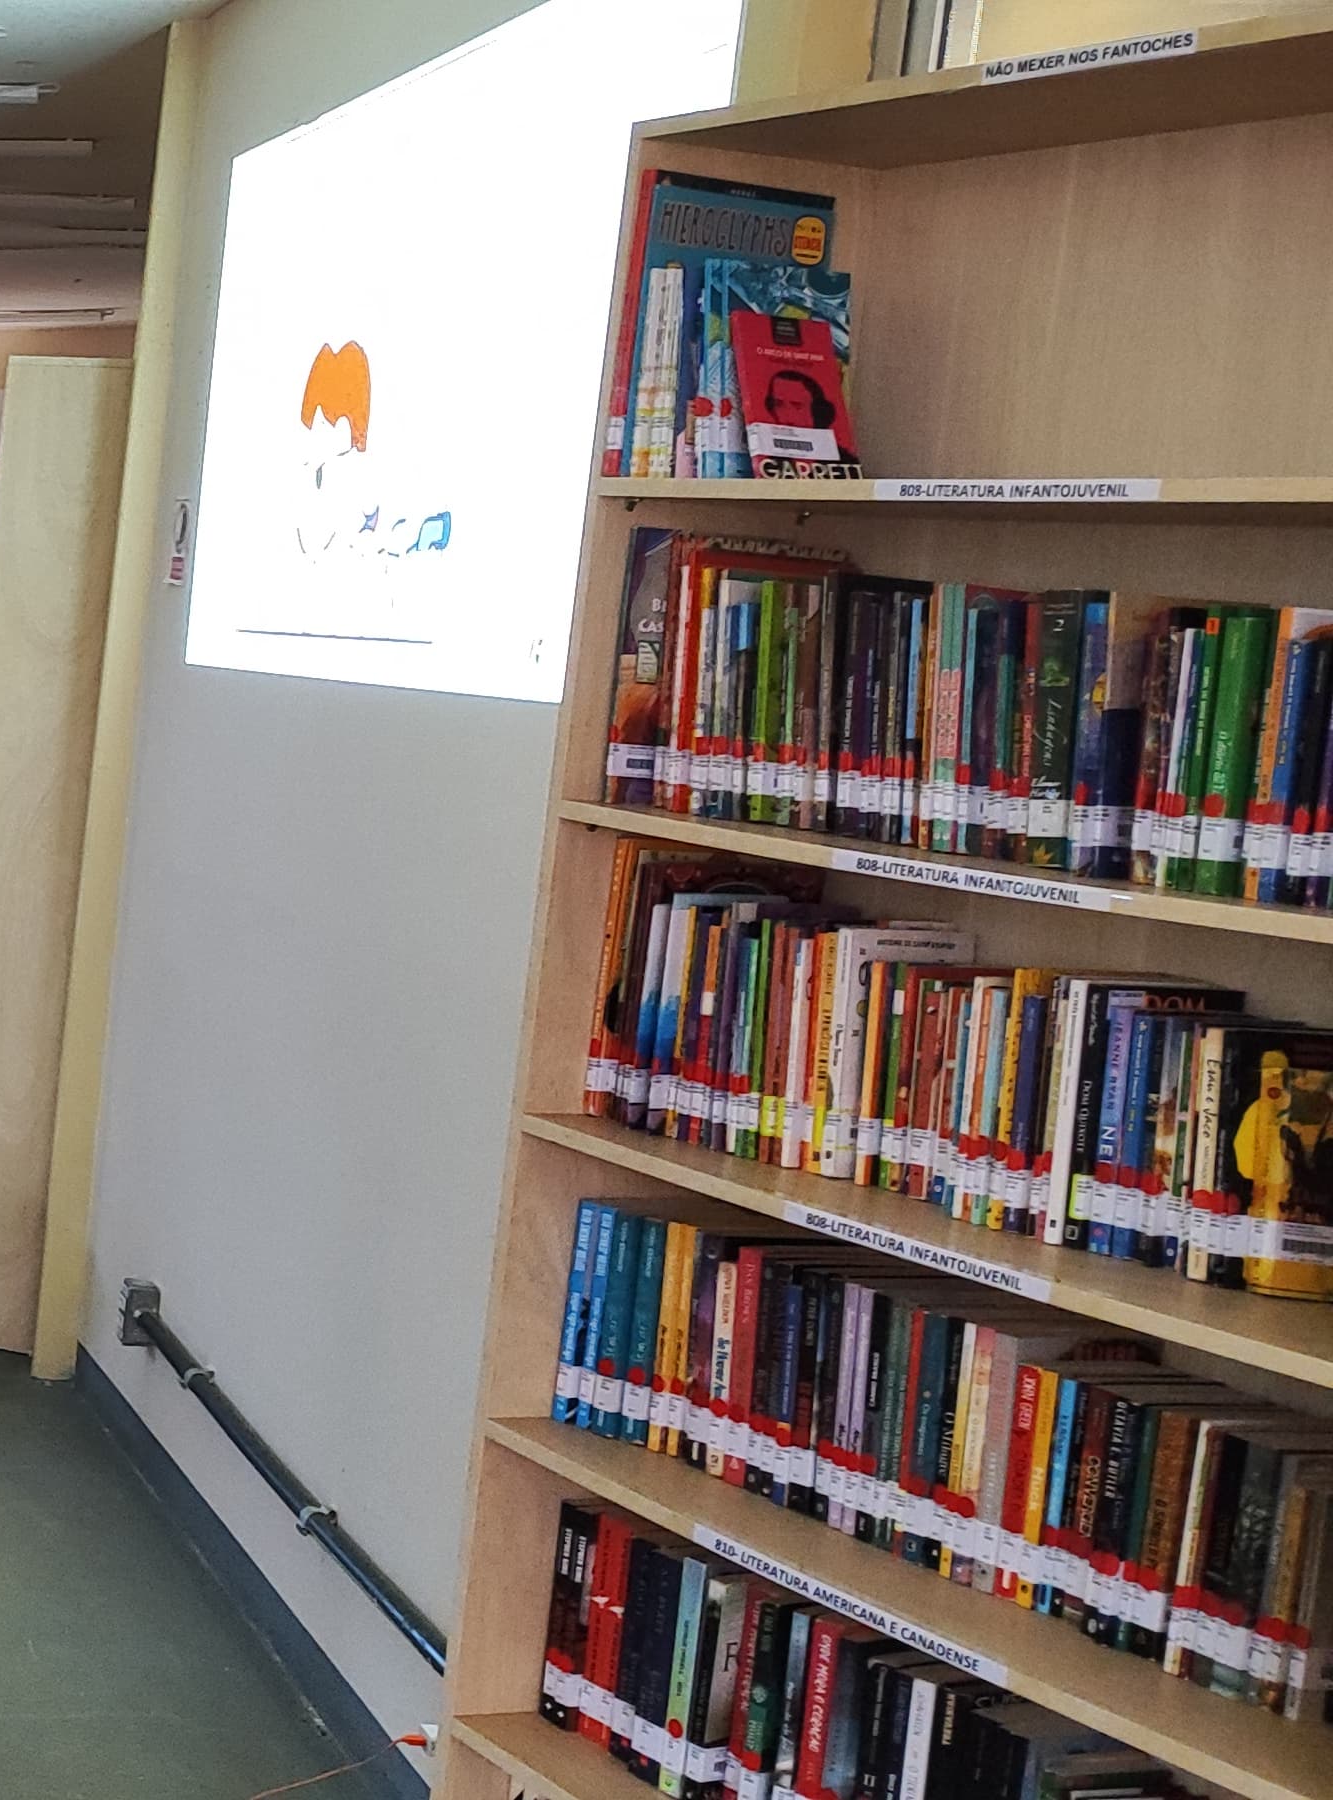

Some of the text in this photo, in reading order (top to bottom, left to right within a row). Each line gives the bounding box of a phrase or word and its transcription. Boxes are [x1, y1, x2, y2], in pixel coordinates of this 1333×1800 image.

[985, 33, 1194, 78] NÃO MEXER NOS FANTOCHES
[759, 458, 863, 480] GARRETT
[1009, 483, 1130, 498] INFANTOJUVENIL
[855, 856, 1080, 905] 808-LITERATURA INFANTOJUVENIL
[1098, 1125, 1117, 1163] NE
[805, 1212, 1023, 1293] 808-LITERATURA INFANTOJUVENIL
[713, 1536, 982, 1673] 810- LITERATURA AMERICANA E CANADENSE
[820, 1633, 833, 1662] ONDE
[815, 1664, 829, 1694] MORA
